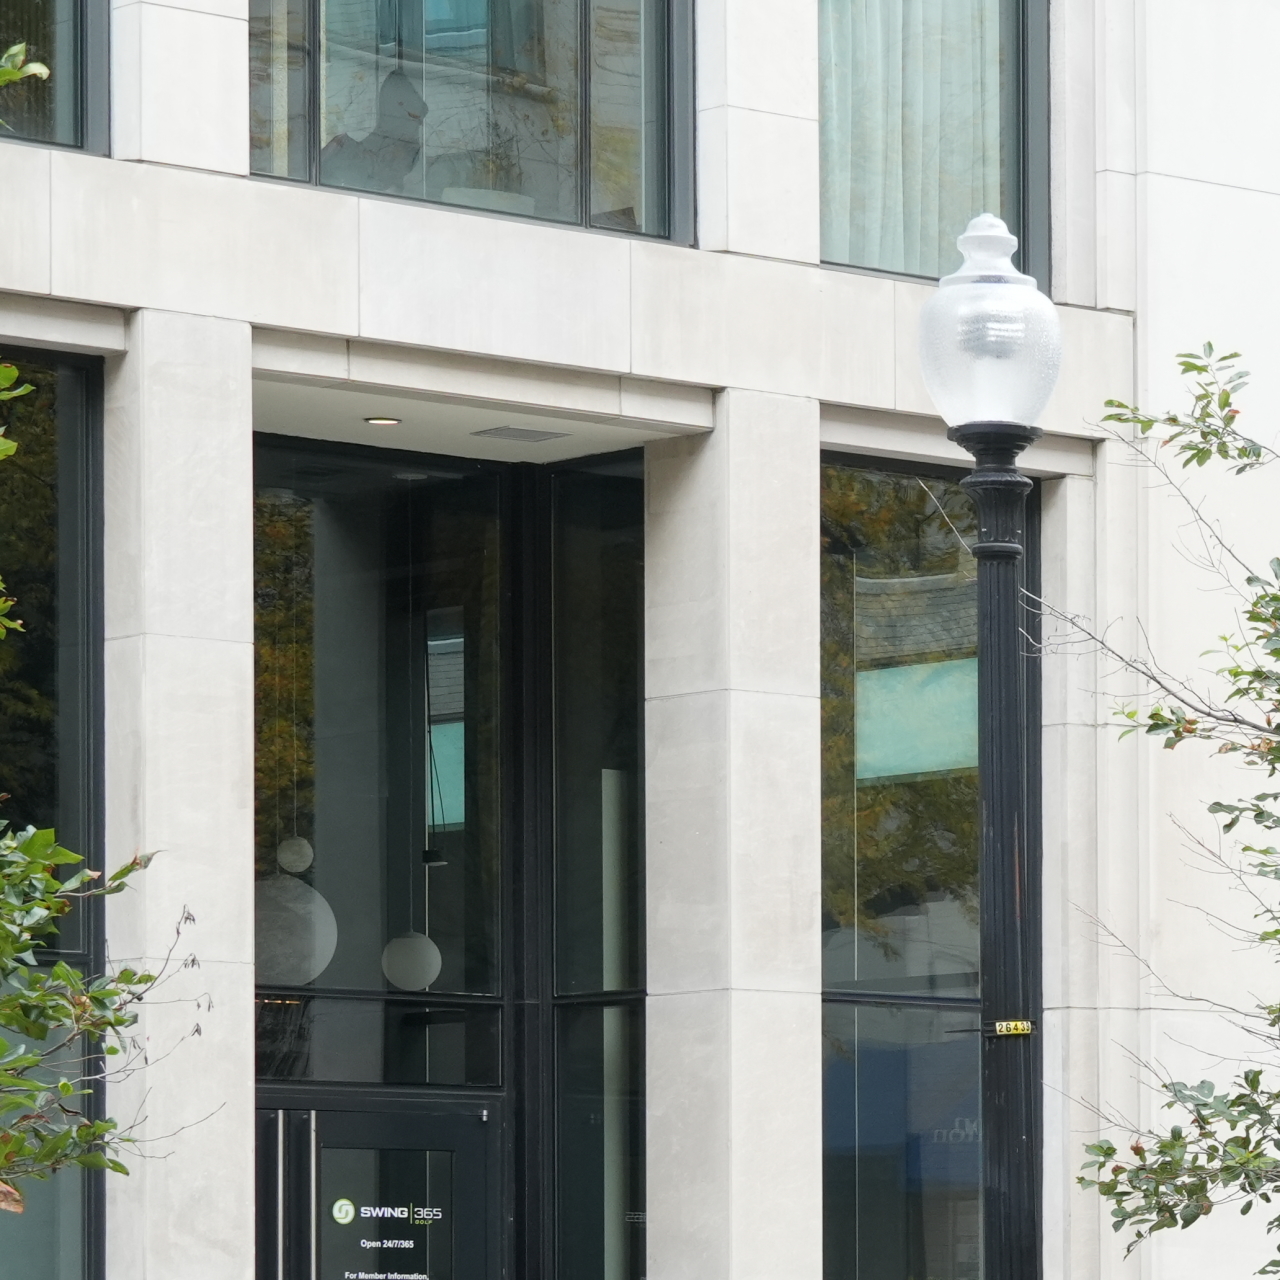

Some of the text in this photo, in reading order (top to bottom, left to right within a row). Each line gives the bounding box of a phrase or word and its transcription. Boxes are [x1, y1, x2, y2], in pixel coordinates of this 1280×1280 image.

[360, 1207, 442, 1219] SWING 365
[360, 1239, 414, 1249] Open 24/7/365
[358, 1272, 386, 1280] Member
